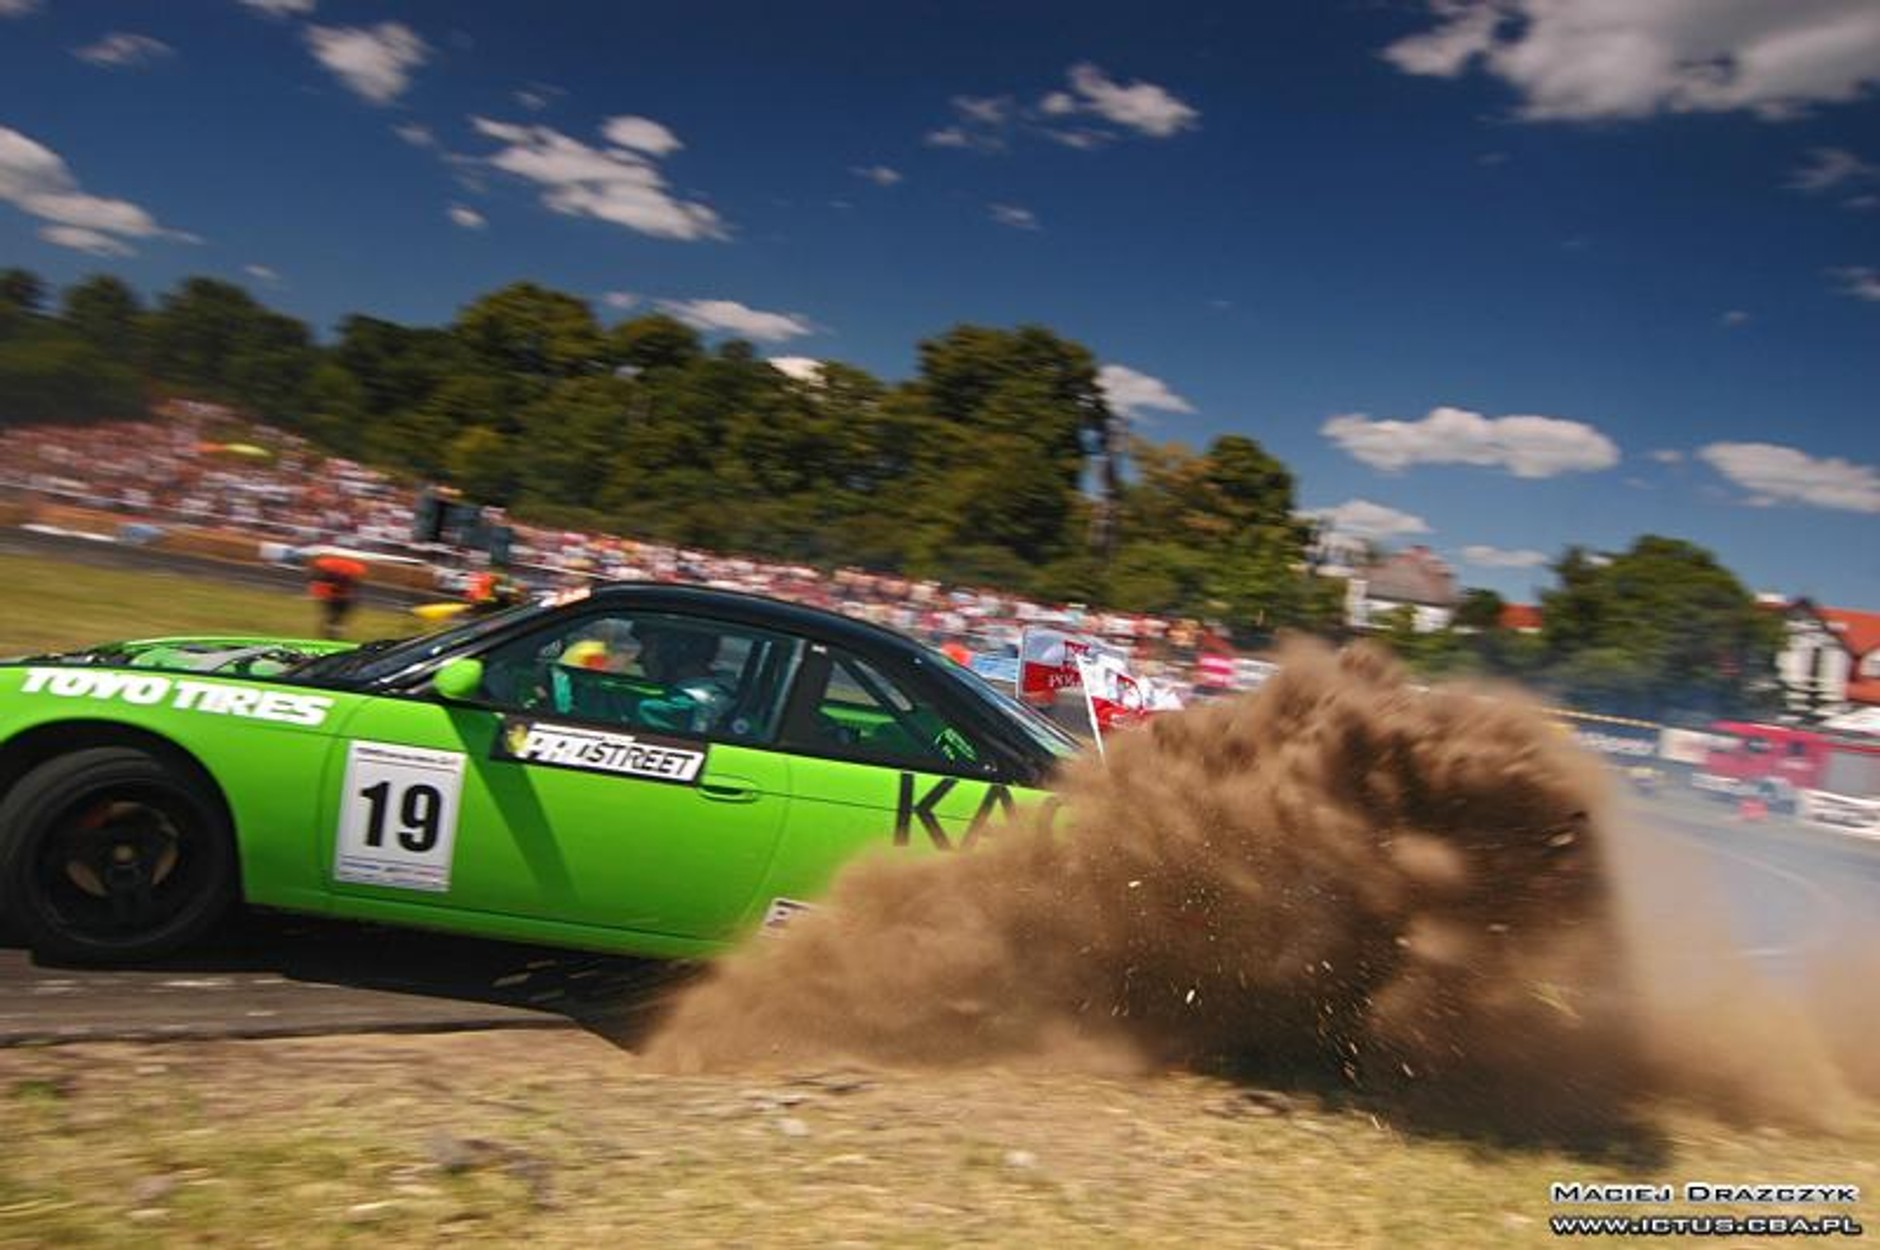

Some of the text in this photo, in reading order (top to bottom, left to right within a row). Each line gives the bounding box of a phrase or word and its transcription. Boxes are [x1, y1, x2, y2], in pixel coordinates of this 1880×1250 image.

[21, 667, 336, 726] TOYO TIRES
[360, 780, 443, 853] 19
